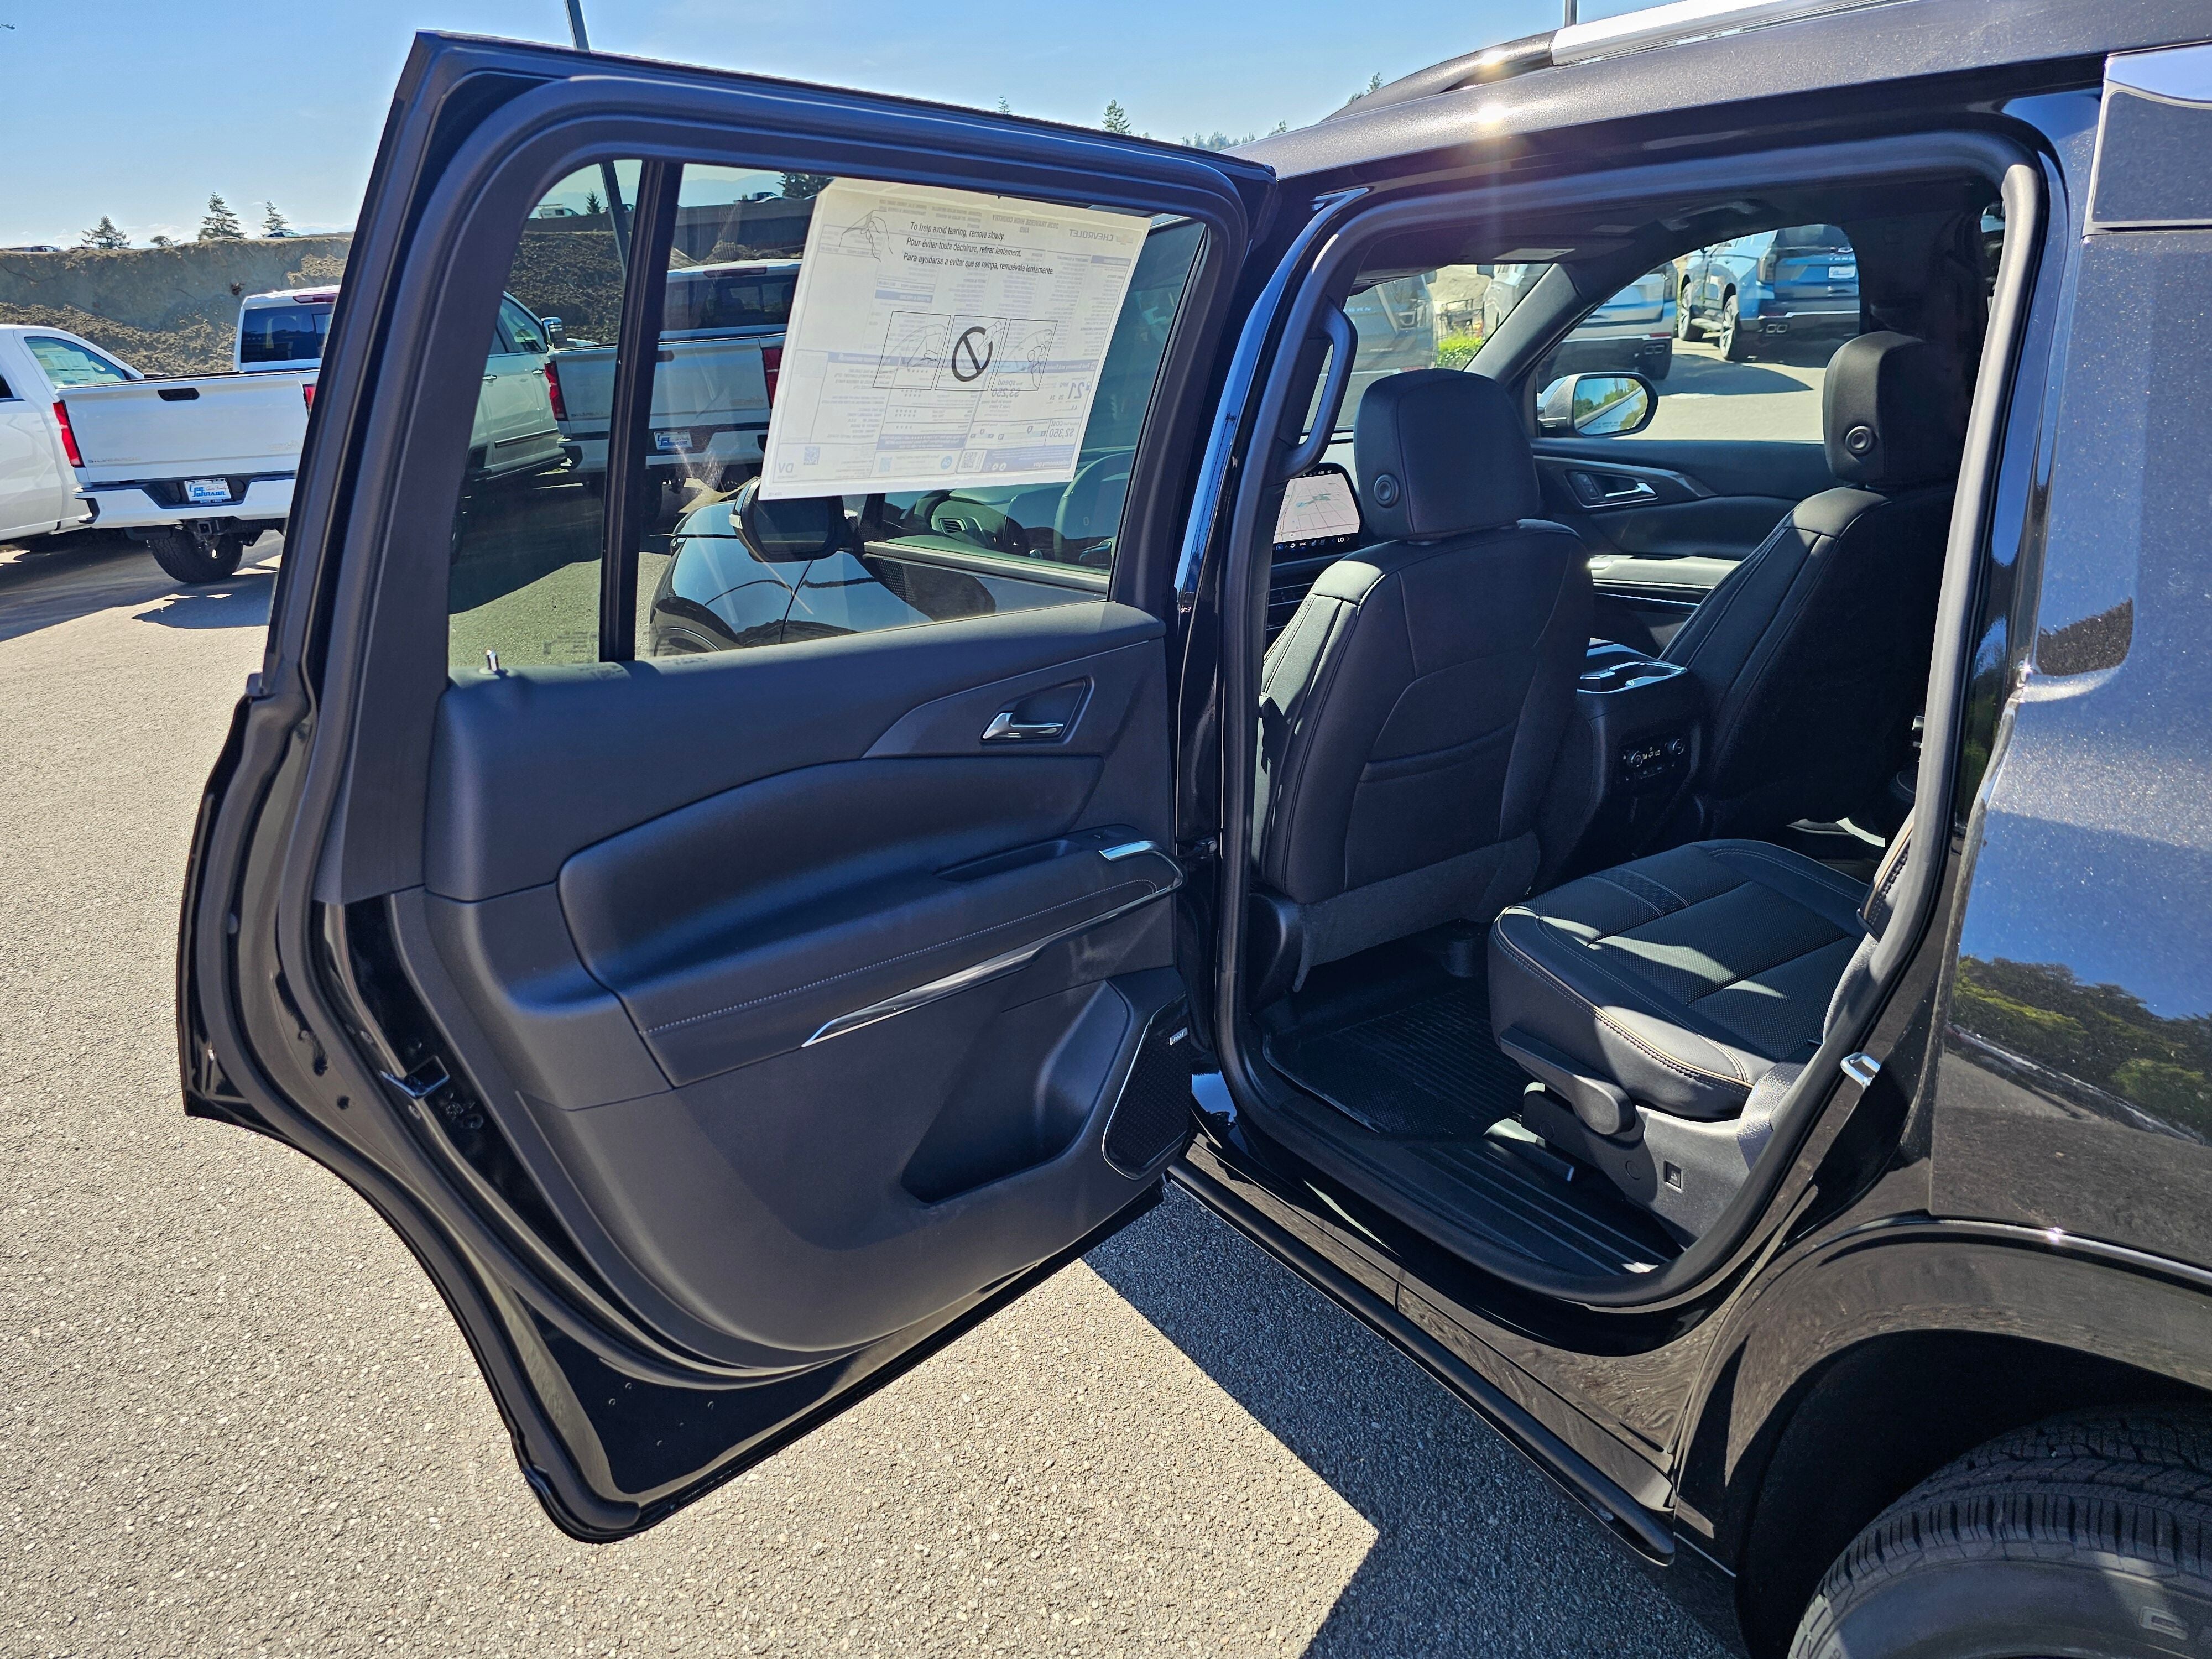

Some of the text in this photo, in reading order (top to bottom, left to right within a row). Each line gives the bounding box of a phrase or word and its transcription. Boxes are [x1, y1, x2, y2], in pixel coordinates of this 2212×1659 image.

[911, 221, 1005, 242] To help avoid tearing, remove slowly.
[906, 237, 921, 247] Pour
[922, 239, 937, 249] éviter
[939, 242, 952, 250] toute
[953, 243, 978, 254] déchirure,
[995, 247, 1021, 257] lentement.
[903, 253, 917, 262] Para
[919, 255, 943, 265] ayudarse
[950, 258, 964, 267] evitar
[999, 262, 1025, 272] remuévala
[1026, 264, 1054, 275] lentamente.
